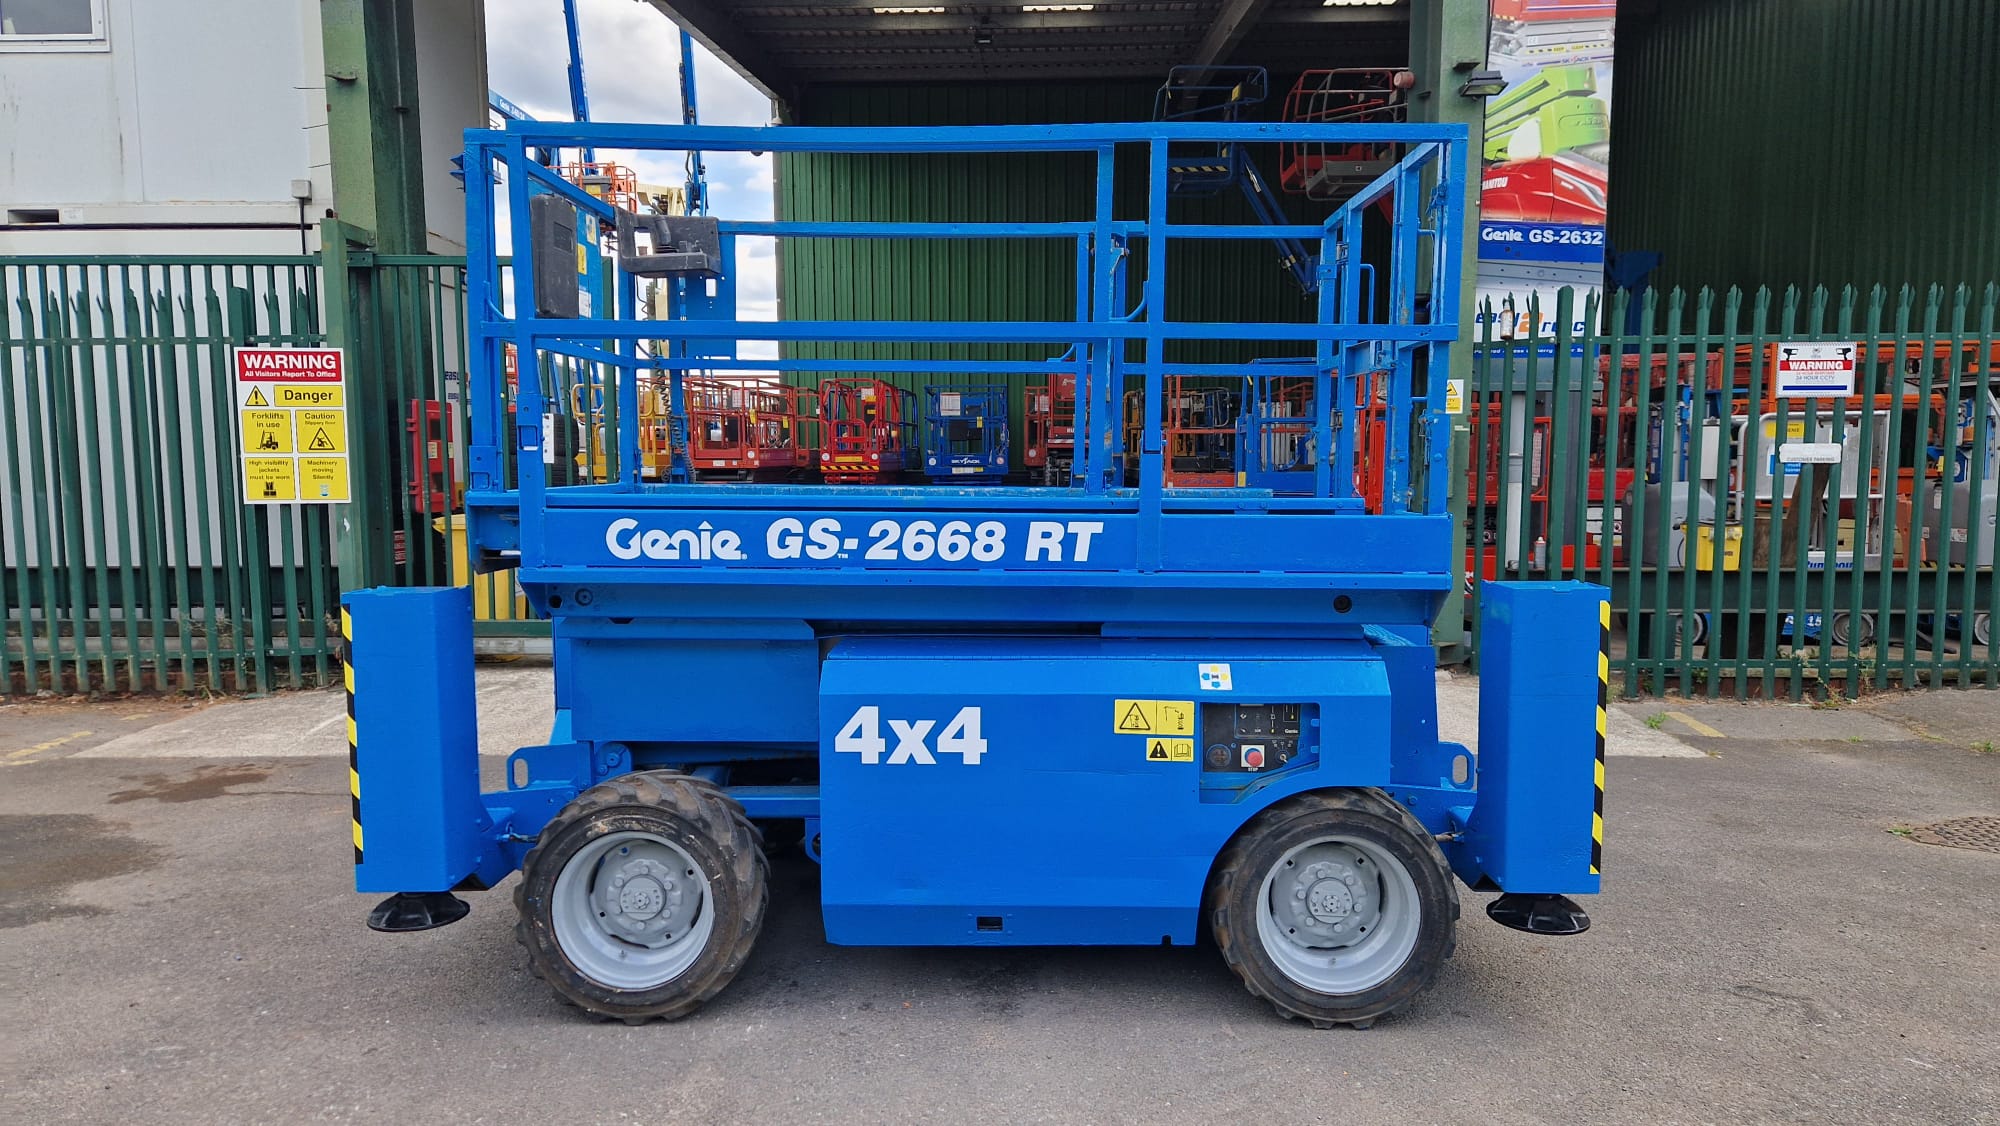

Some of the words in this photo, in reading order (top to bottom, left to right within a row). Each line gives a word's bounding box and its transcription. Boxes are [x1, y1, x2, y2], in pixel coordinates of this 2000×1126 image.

[1482, 227, 1523, 241] Genie
[1529, 229, 1604, 245] GS-2632
[243, 354, 336, 369] WARNING
[1789, 361, 1844, 370] WARNING
[284, 390, 333, 403] Danger
[252, 412, 284, 420] Forklifts
[304, 412, 336, 420] Caution
[605, 517, 748, 561] Genie
[1025, 521, 1104, 563] RT
[834, 706, 988, 765] 4x4
